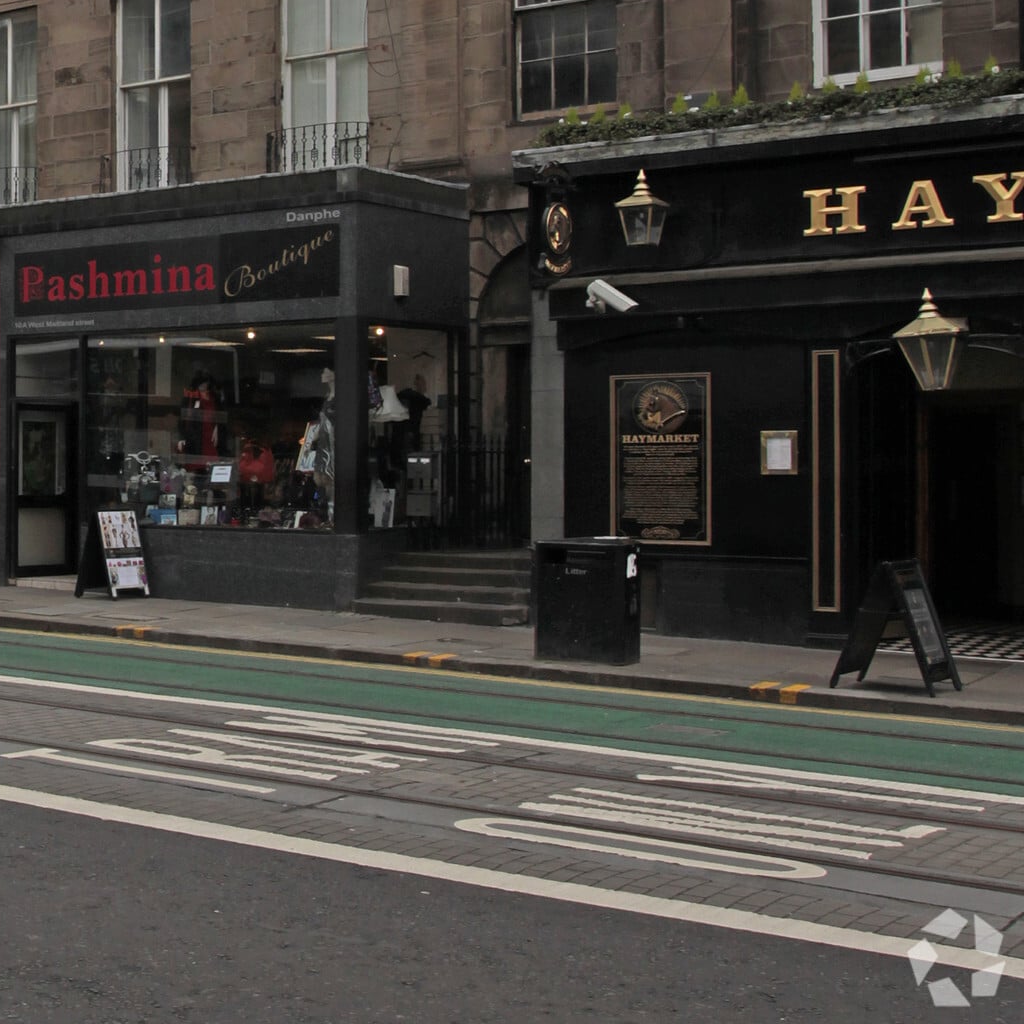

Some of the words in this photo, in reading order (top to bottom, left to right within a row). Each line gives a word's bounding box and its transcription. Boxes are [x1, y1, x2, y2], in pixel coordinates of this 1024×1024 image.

[802, 170, 1024, 237] HAY
[286, 207, 341, 224] Danphe
[20, 254, 215, 304] Pashmina
[223, 227, 335, 297] Boutique
[622, 433, 700, 444] HAYMARKET
[564, 567, 588, 575] Litter
